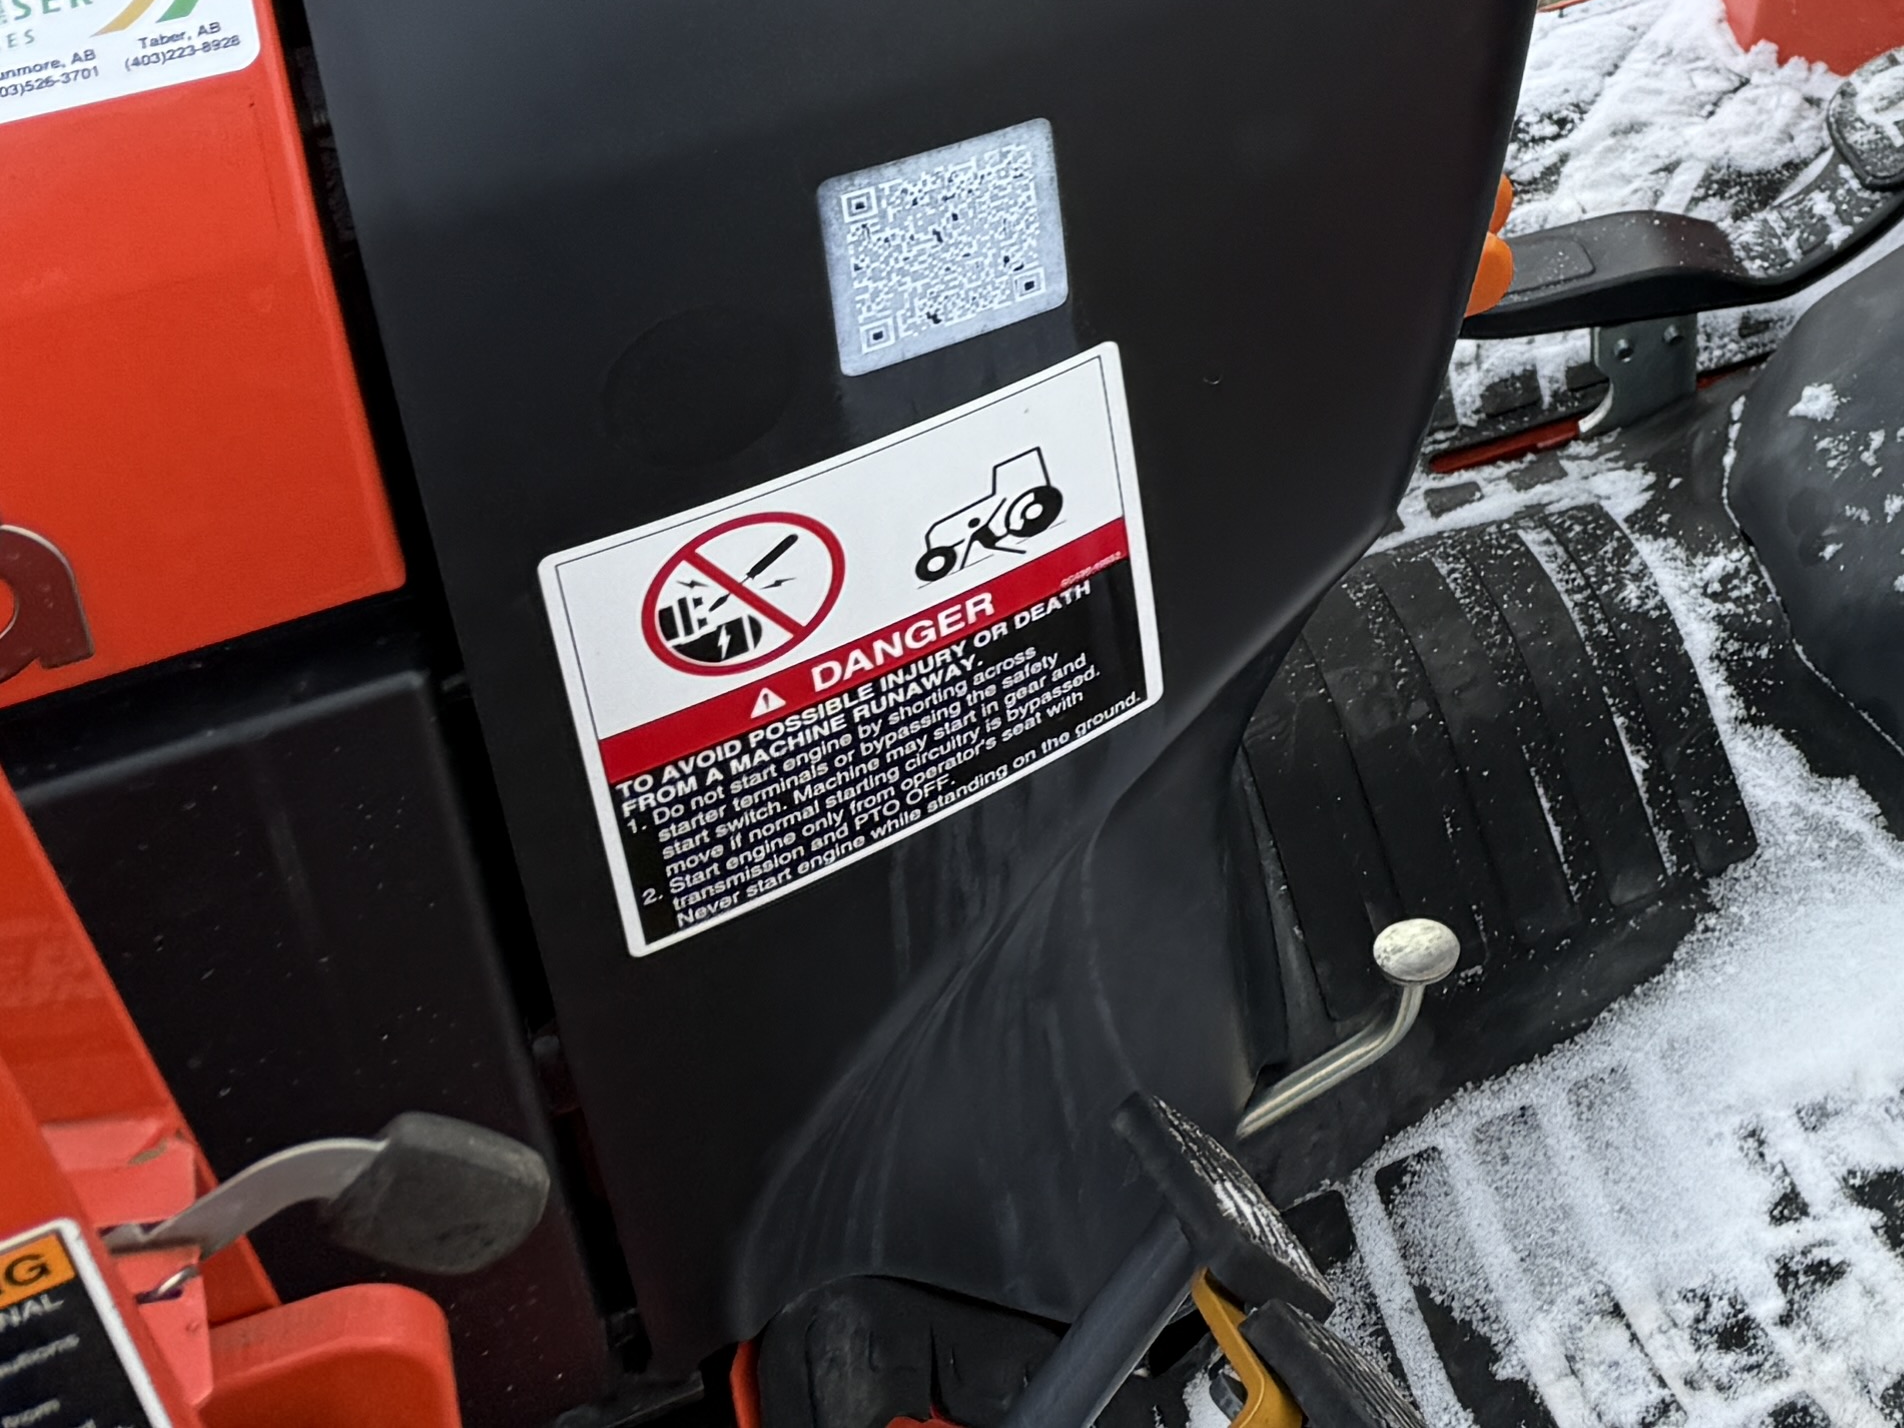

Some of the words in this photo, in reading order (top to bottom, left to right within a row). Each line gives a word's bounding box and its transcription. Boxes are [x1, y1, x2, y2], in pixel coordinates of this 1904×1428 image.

[0, 59, 66, 82] unmore,
[71, 48, 97, 64] AB
[0, 65, 99, 98] 03)526-3701
[137, 31, 192, 50] Taber,
[197, 21, 222, 38] AB
[614, 773, 654, 798] TO
[661, 739, 742, 783] AVOID
[748, 682, 874, 747] POSSIBLE
[879, 639, 966, 691] INJURY
[972, 621, 1008, 648] OR
[1013, 579, 1090, 629] DEATH
[621, 775, 698, 817] FROM
[704, 766, 724, 786] A
[729, 713, 846, 774] MACHINE
[852, 653, 982, 722] RUNAWAY.
[811, 592, 993, 691] DANGER
[626, 817, 647, 834] 1.
[651, 803, 685, 825] Do
[689, 784, 725, 810] not
[729, 763, 778, 794] start
[782, 732, 852, 772] engine
[856, 717, 882, 739] by
[887, 679, 968, 725] shorting
[972, 646, 1036, 686] across
[641, 886, 663, 906] 2.
[668, 861, 720, 894] Start
[725, 831, 796, 870] engine
[800, 808, 843, 837] only
[848, 784, 895, 815] from
[899, 736, 997, 791] operator's
[1000, 711, 1042, 742] seat
[1045, 691, 1083, 717] with
[657, 804, 726, 842] starter
[732, 757, 828, 811] terminals
[833, 748, 855, 768] or
[859, 700, 961, 756] bypassing
[964, 683, 997, 707] the
[1001, 652, 1058, 689] safety
[661, 828, 710, 860] start
[714, 800, 787, 838] switch.
[792, 752, 880, 804] Machine
[884, 733, 927, 763] may
[932, 709, 977, 740] start
[980, 699, 999, 717] in
[1003, 674, 1047, 709] gear
[1049, 651, 1086, 682] and
[664, 843, 724, 877] move
[729, 831, 742, 850] if
[748, 799, 820, 843] normal
[824, 765, 900, 813] starting
[904, 726, 980, 771] circuitry
[984, 716, 1002, 733] is
[1005, 664, 1100, 722] bypassed.
[676, 890, 740, 928] Never
[745, 866, 792, 898] start
[796, 834, 865, 874] engine
[869, 807, 921, 838] while
[926, 763, 1008, 813] standing
[1011, 748, 1037, 769] on
[1040, 730, 1070, 754] the
[1074, 690, 1142, 737] ground.
[672, 838, 804, 916] transmission
[810, 821, 849, 851] and
[853, 798, 900, 830] PTO
[904, 772, 955, 805] OFF.
